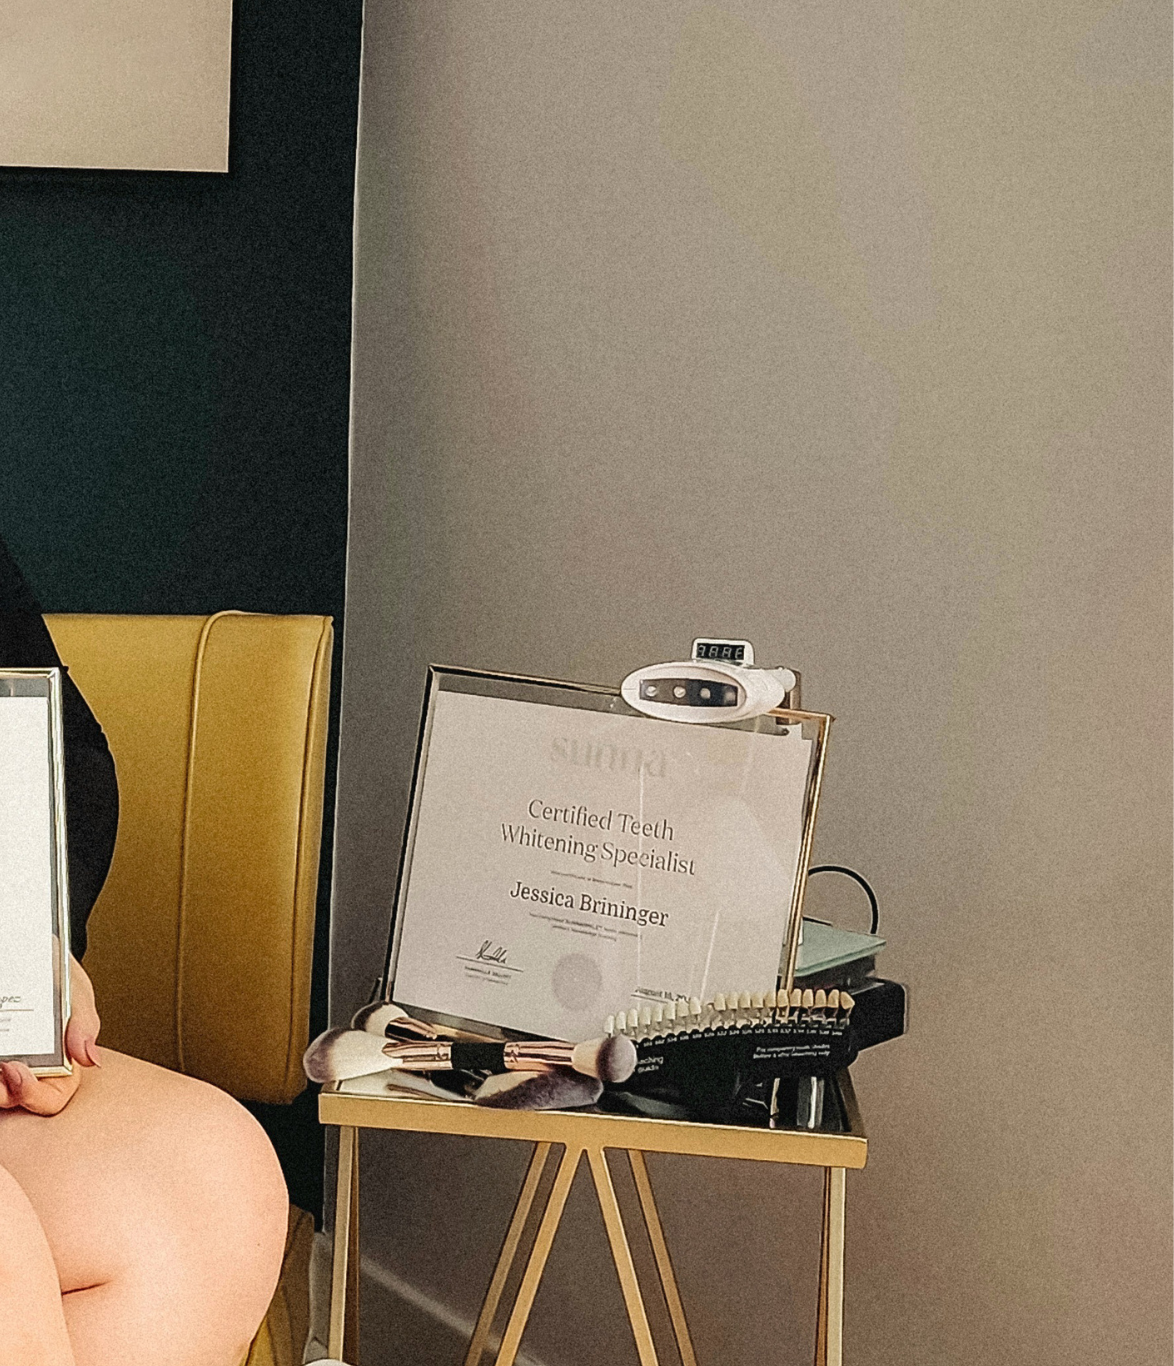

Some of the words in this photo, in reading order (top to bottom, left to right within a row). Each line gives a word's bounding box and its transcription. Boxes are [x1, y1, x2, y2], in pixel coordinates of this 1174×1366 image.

[528, 799, 613, 831] Certified
[618, 812, 674, 841] Teeth
[501, 823, 599, 863] Whitening
[600, 841, 695, 876] Specialist
[510, 881, 575, 909] Jessica
[579, 893, 669, 927] Brininger
